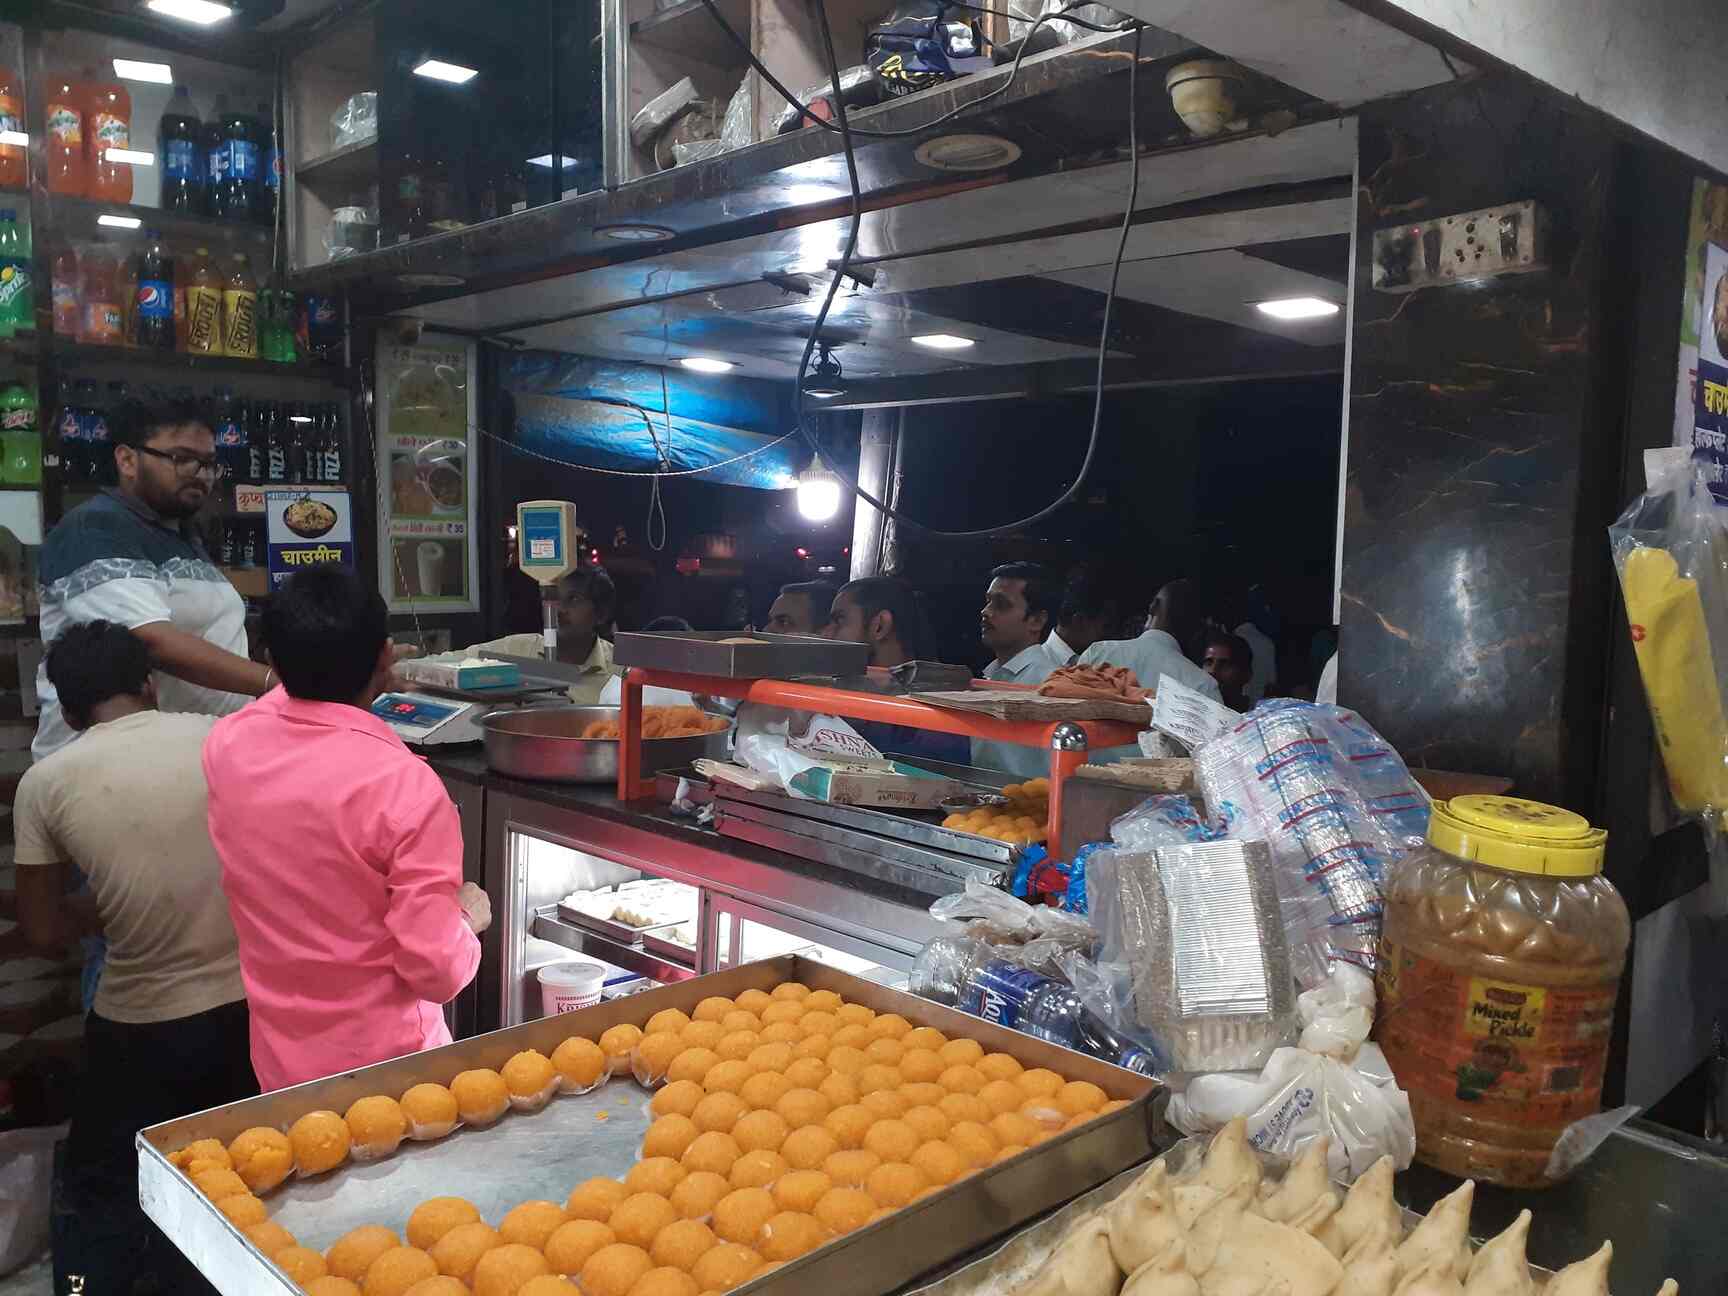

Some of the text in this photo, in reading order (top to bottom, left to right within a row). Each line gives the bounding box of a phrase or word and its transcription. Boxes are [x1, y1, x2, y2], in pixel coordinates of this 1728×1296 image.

[268, 446, 285, 480] FIZZ
[324, 449, 341, 481] FIZZ
[280, 543, 342, 566] चाउमीन
[1472, 1001, 1521, 1020] Mixed
